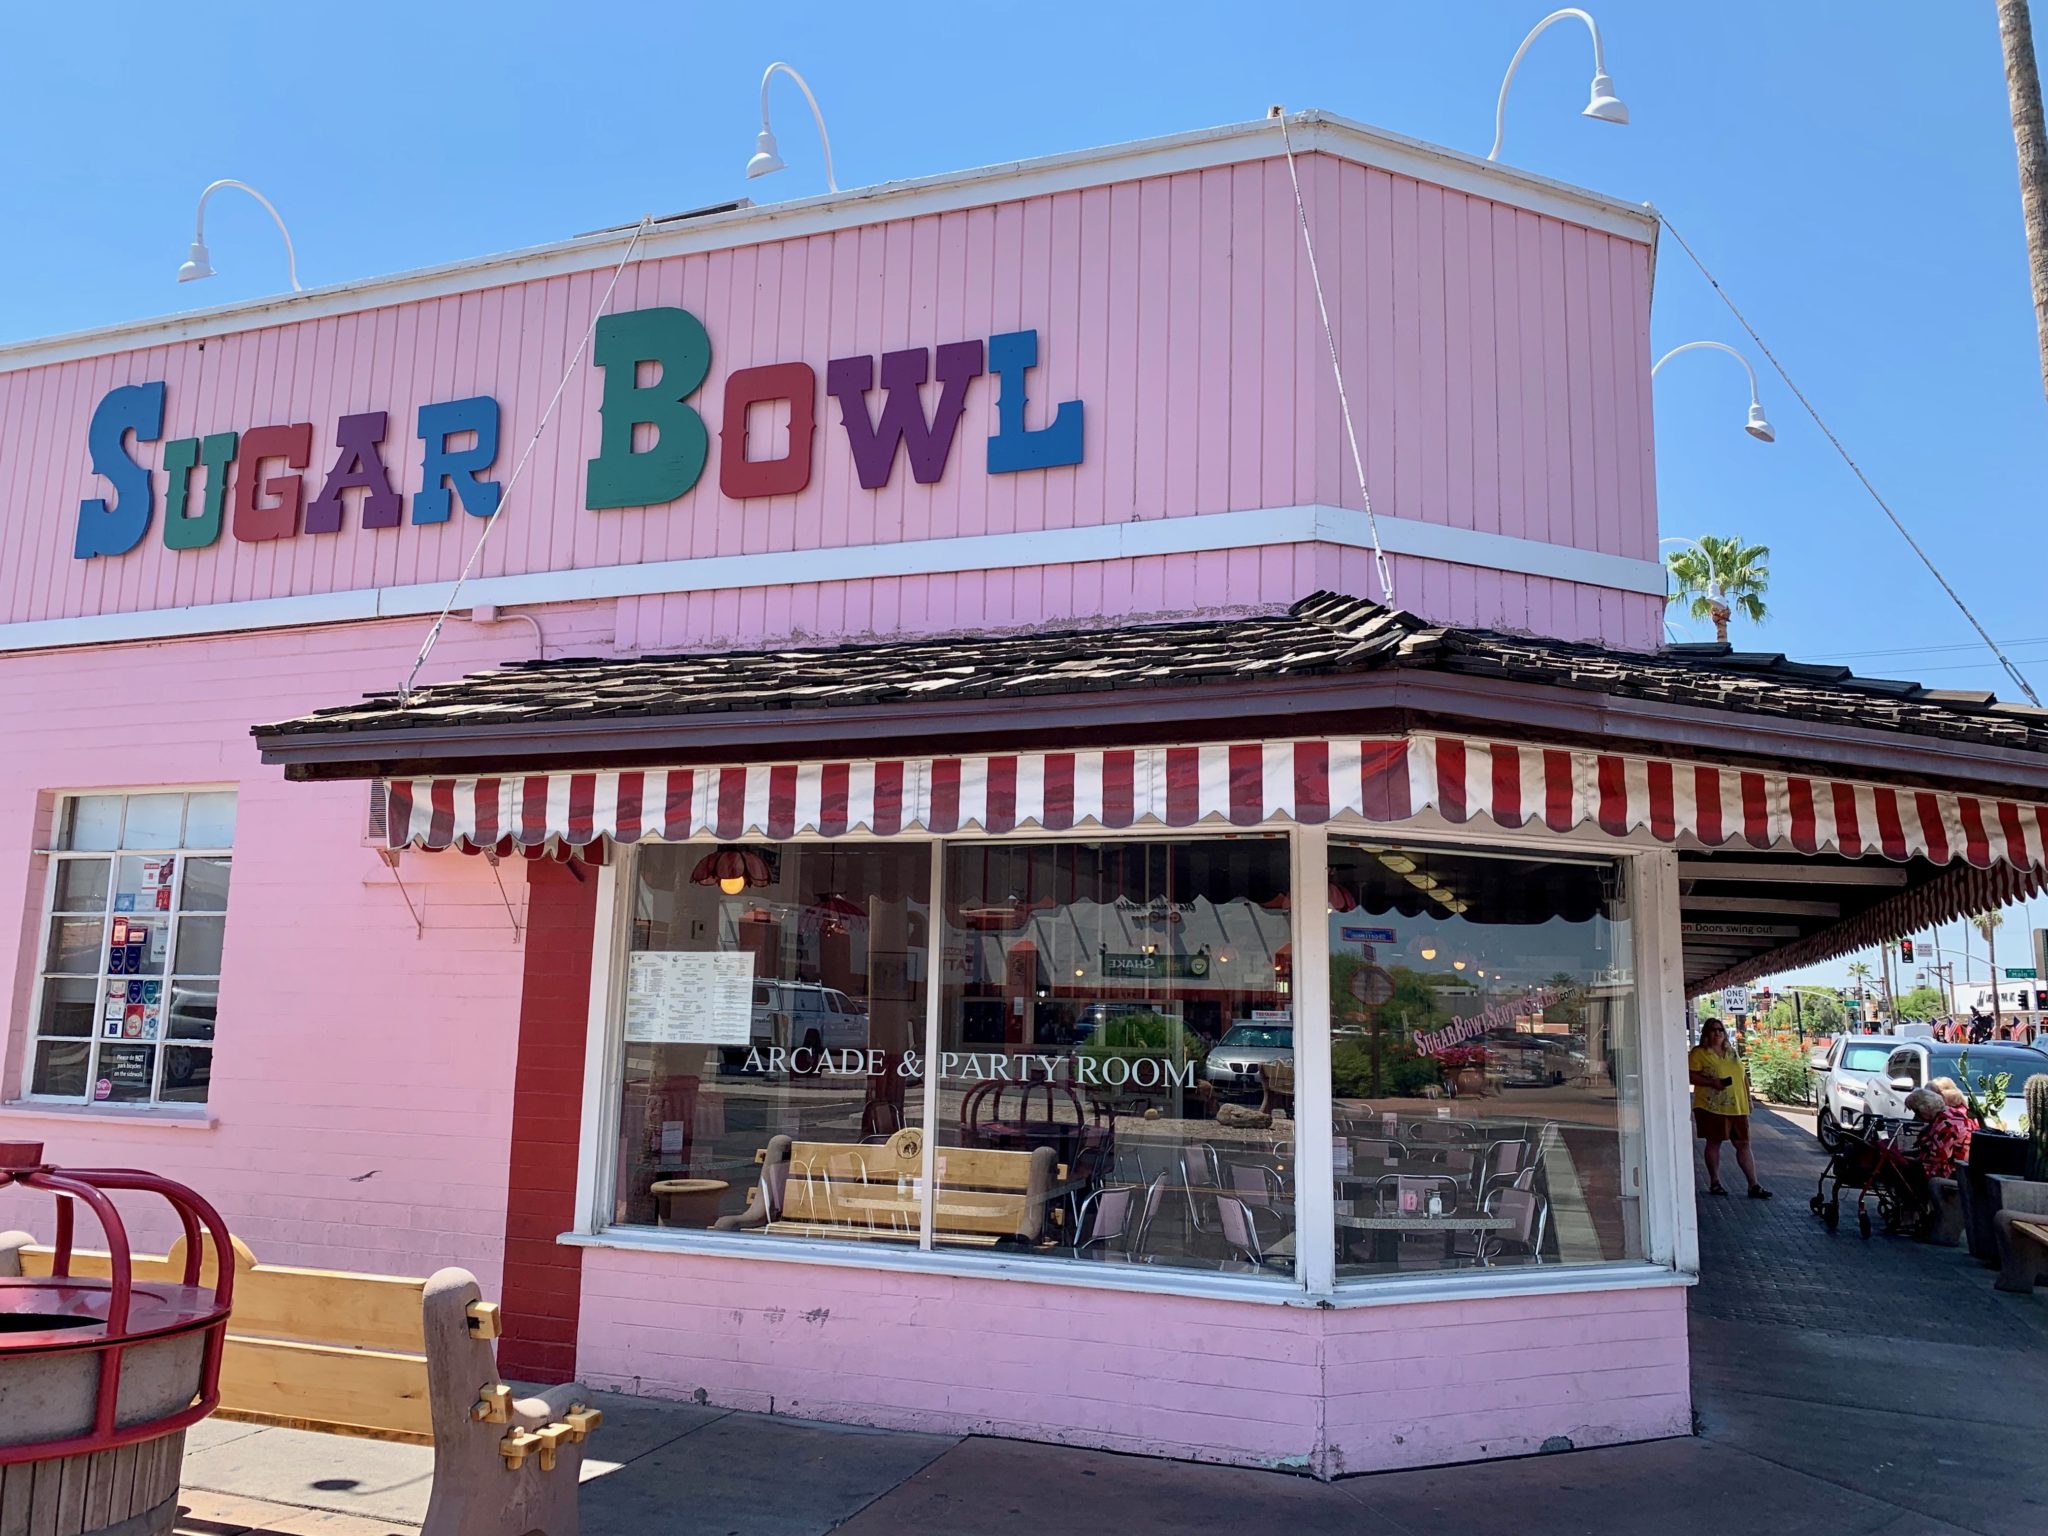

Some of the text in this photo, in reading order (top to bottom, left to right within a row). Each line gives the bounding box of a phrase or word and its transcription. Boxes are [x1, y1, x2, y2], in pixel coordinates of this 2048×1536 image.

[75, 306, 1084, 559] SUGAR BOWL
[1696, 923, 1724, 932] Doors
[1727, 924, 1754, 934] swing
[1756, 926, 1774, 934] out
[1726, 990, 1743, 998] ONE
[1726, 998, 1745, 1006] WAY
[135, 1054, 144, 1062] NOT
[741, 1046, 1199, 1089] ARCADE & PARTY ROOM
